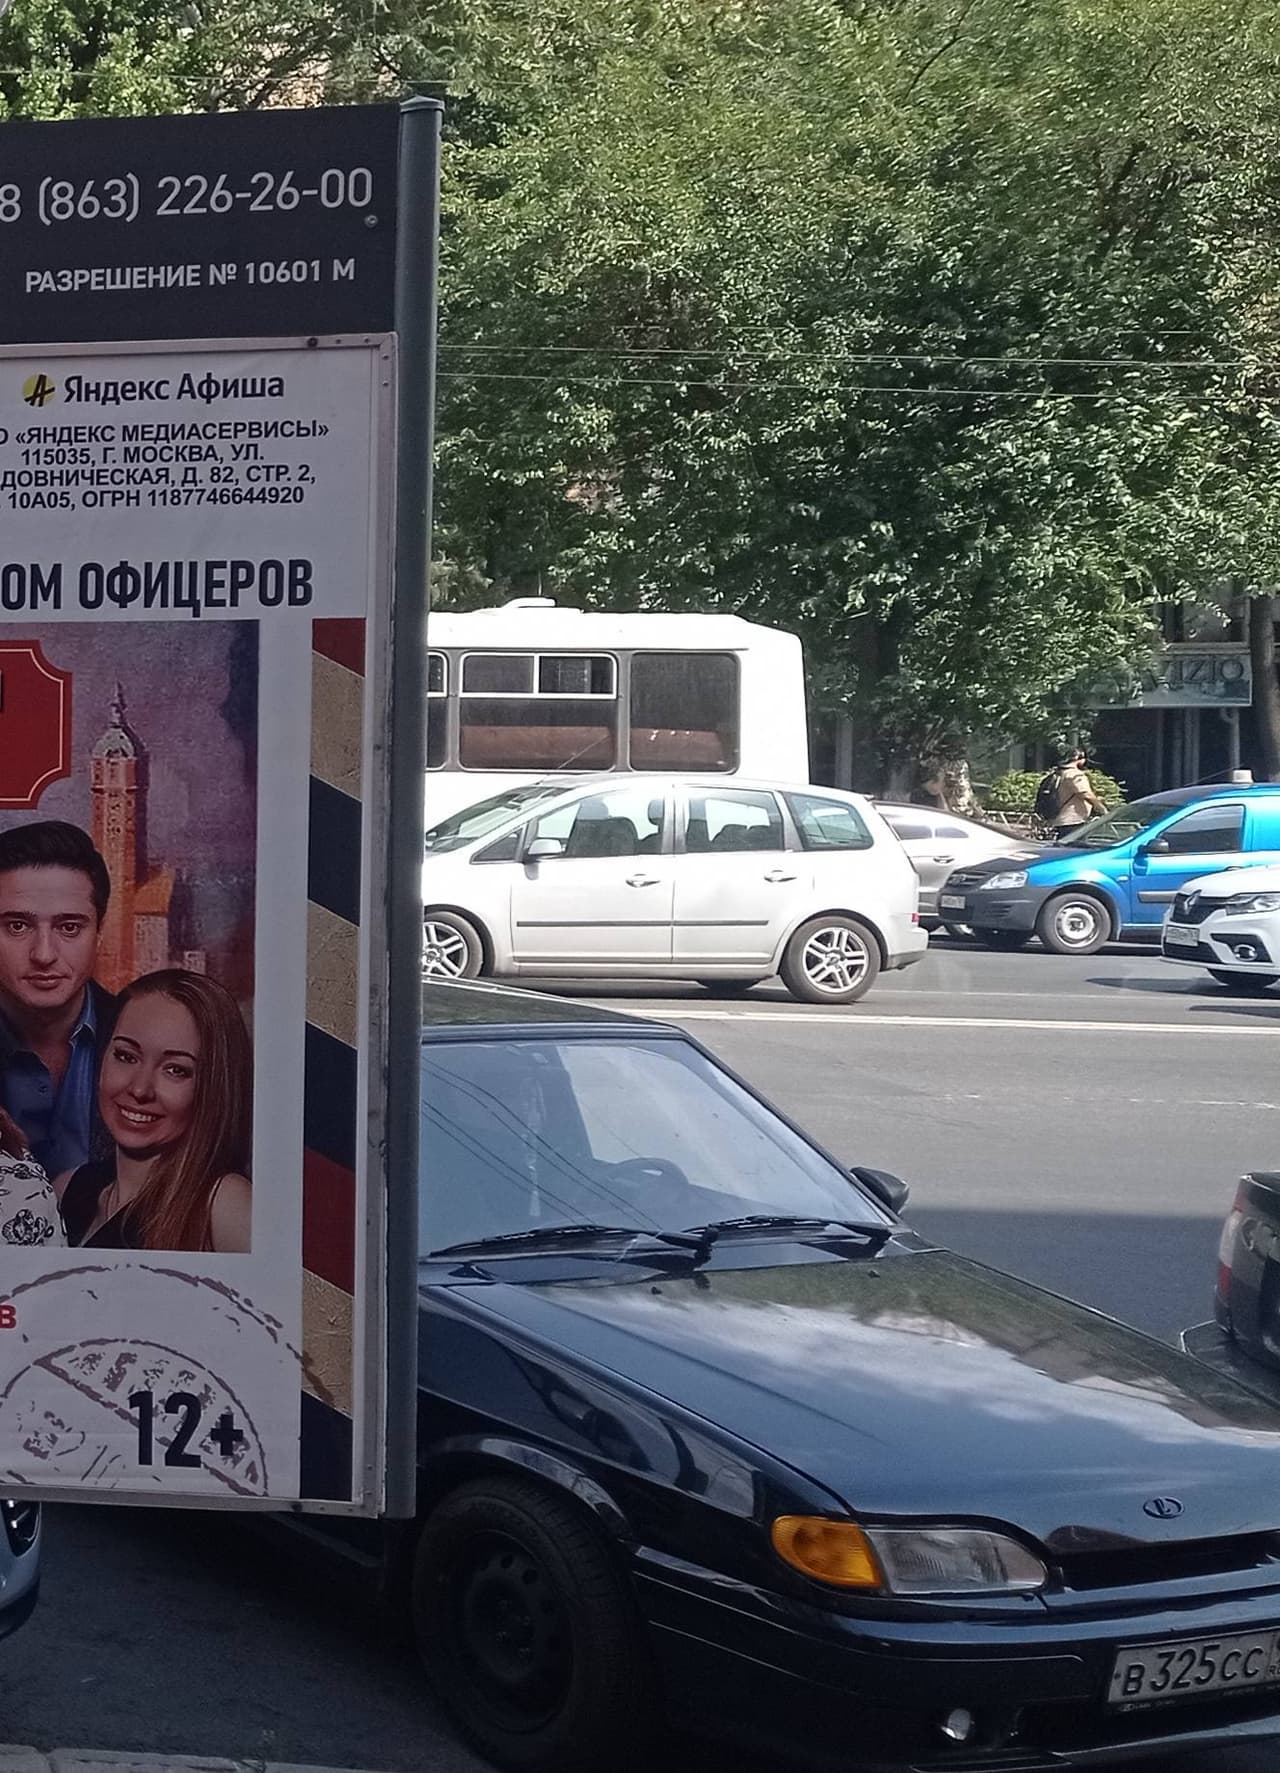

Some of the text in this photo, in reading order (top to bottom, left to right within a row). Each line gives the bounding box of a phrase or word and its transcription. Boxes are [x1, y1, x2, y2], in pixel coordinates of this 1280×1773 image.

[39, 173, 139, 225] (863)
[157, 168, 371, 215] 226-26-00
[26, 258, 354, 292] РАЗРЕШЕНИЕ № 10601 М
[64, 373, 284, 405] Яндекс Афиша
[16, 425, 115, 446] «ЯНДЕКС
[122, 420, 328, 444] МЕДИАСЕРВИСЫ»
[22, 444, 264, 467] 115035, Г. МОСКВА, УЛ.
[181, 467, 202, 487] Д.
[210, 466, 239, 485] 82,
[246, 465, 291, 482] СТР.
[298, 465, 315, 484] 2,
[8, 492, 75, 511] 10А05,
[83, 490, 140, 507] ОГРН
[148, 487, 304, 506] 1187746644920
[79, 559, 312, 617] ОФИЦЕРОВ
[128, 1390, 244, 1468] 12+
[1122, 1644, 1264, 1696] В325СС
